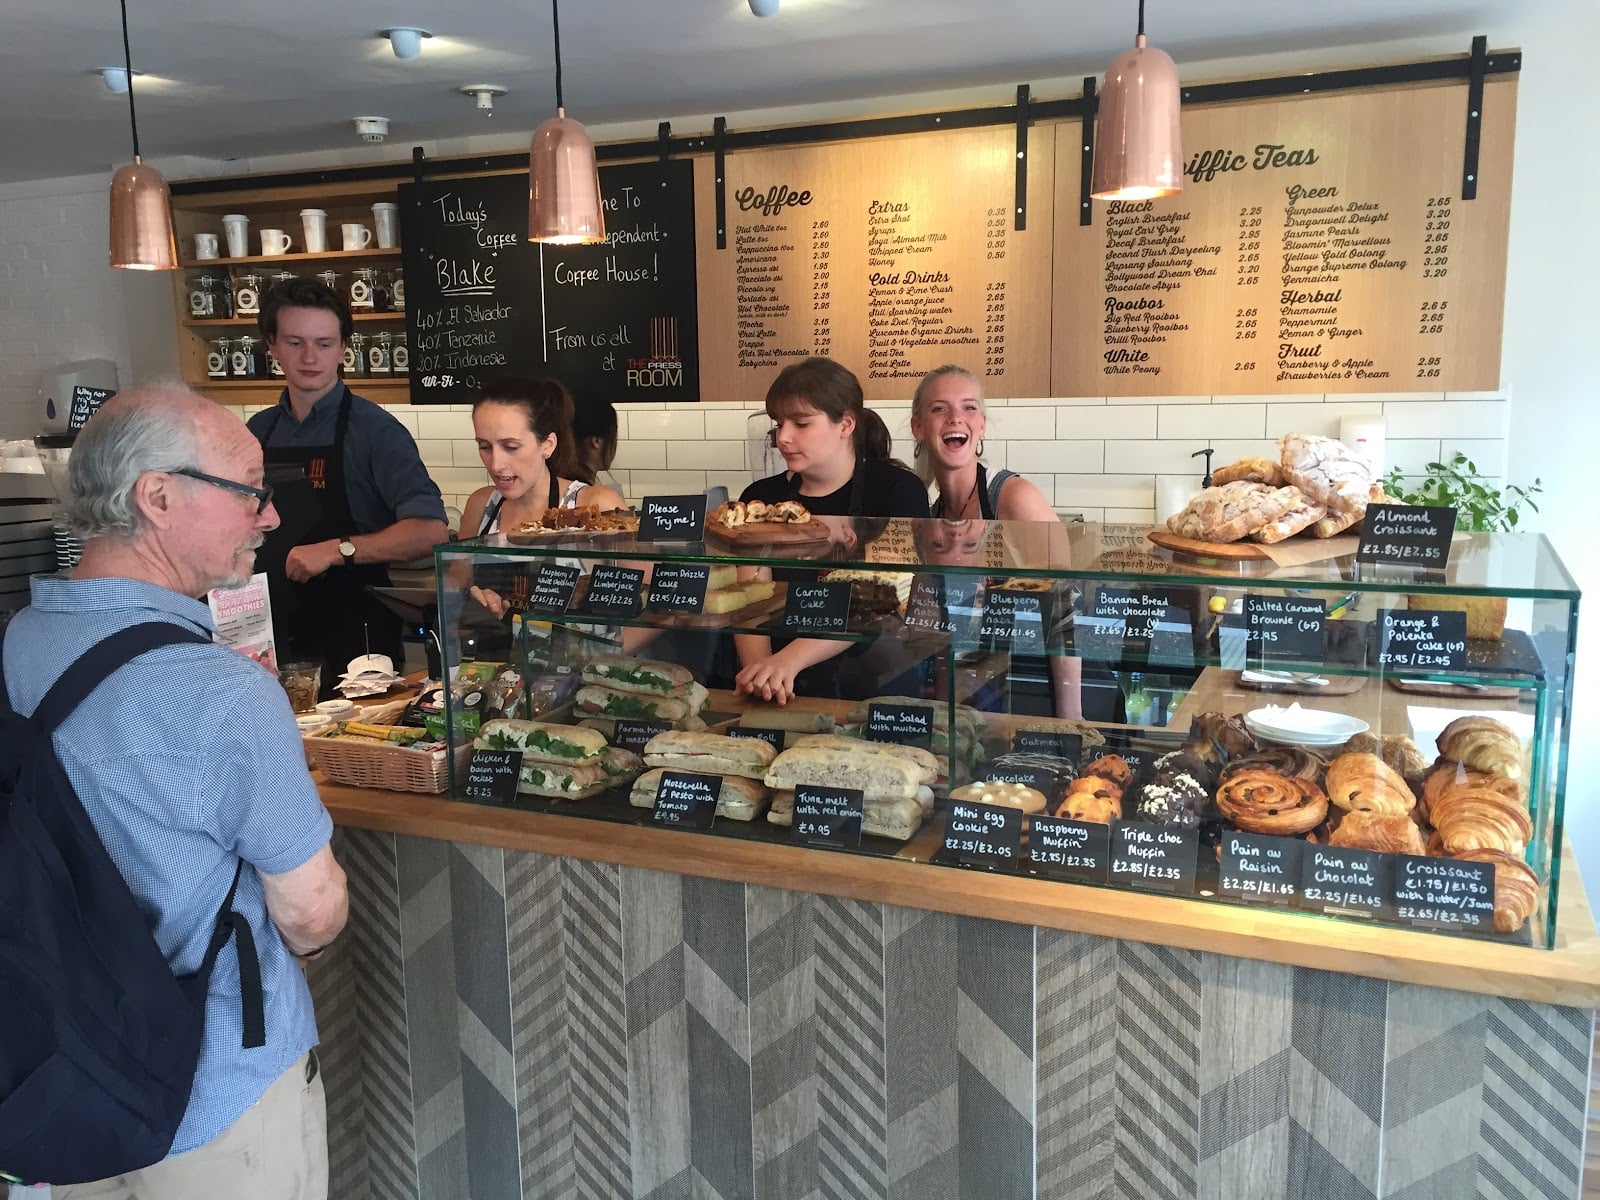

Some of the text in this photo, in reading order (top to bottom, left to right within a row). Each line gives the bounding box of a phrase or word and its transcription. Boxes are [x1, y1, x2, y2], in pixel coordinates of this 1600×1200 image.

[1252, 144, 1319, 170] Teas
[621, 186, 641, 209] To
[735, 184, 813, 217] Coffee
[1286, 184, 1339, 205] Green
[433, 192, 487, 230] Today's
[868, 200, 910, 215] Extras
[1106, 200, 1155, 215] Black
[1106, 206, 1263, 228] English Breakfast 2.25
[1106, 218, 1262, 240] Royal Earl Grey 3.20
[476, 228, 518, 249] Coffee
[868, 245, 933, 257] Whipped Cream
[868, 258, 895, 267] Honey
[554, 262, 600, 287] Coffee
[868, 271, 951, 286] Cold Drinks
[1281, 268, 1447, 287] Genmaicha 3.20
[1280, 289, 1342, 306] Herbal
[1104, 297, 1165, 314] Rooibos
[1280, 306, 1338, 316] Chamomile
[416, 308, 443, 331] 40%
[463, 301, 512, 324] Salvador
[1279, 313, 1444, 328] Peppermint 2.65
[738, 321, 764, 330] Mocha
[416, 329, 497, 352] 40% Tanzania
[549, 324, 632, 351] From us all
[1104, 330, 1258, 345] Chilli Rooibos 2.65
[868, 346, 1005, 358] Iced Tea 2.95
[1103, 349, 1150, 363] White
[1278, 343, 1322, 359] Fruit
[444, 350, 508, 370] Indonesia
[602, 351, 616, 372] at
[627, 358, 682, 370] THE PRESS
[738, 359, 778, 369] Babychino
[1103, 362, 1256, 376] White Peony 2.65
[1276, 369, 1342, 382] Strawberries
[1354, 369, 1390, 379] Cream
[1416, 368, 1440, 378] 2.65
[421, 374, 454, 388] Wi-Fi
[626, 369, 683, 388] ROOM
[648, 503, 680, 515] Please
[1374, 509, 1431, 522] Almond
[654, 515, 672, 531] Try
[1373, 524, 1438, 536] Croissant
[595, 569, 614, 579] Apple
[655, 568, 706, 579] Lemon Drizzle
[594, 580, 634, 591] Lumberjack
[795, 587, 829, 598] Carrot
[800, 599, 826, 609] Cake
[991, 594, 1039, 610] Blueberry
[1100, 592, 1169, 606] Banana Bread
[217, 600, 265, 619] SMOOTHIES
[1096, 607, 1166, 617] with chocolate
[1247, 599, 1324, 614] Salted Caramel
[1251, 614, 1294, 625] Brownie
[1384, 615, 1440, 632] Orange &
[1388, 630, 1434, 641] Polenta
[1416, 641, 1444, 651] Cake
[873, 710, 928, 725] Ham Salad
[869, 723, 928, 734] with mustard
[1020, 738, 1064, 747] Oatmeal
[469, 764, 513, 774] bacon with
[468, 775, 494, 783] rocket
[663, 778, 711, 792] Mozzerella
[986, 773, 1036, 784] Chocolate
[695, 794, 715, 802] with
[798, 792, 849, 806] Tuna melt
[657, 800, 689, 811] Tomato
[797, 806, 862, 818] with red onion
[953, 805, 1005, 828] Mini egg
[1035, 821, 1088, 841] Raspberry
[1121, 827, 1183, 845] Triple choc
[1043, 836, 1082, 849] Muffin
[1231, 839, 1282, 859] Pain au
[1128, 844, 1166, 858] Muffin
[1239, 859, 1283, 874] Raisin
[1315, 853, 1369, 872] Pain au
[1406, 861, 1482, 881] Croissant
[1395, 889, 1424, 901] with
